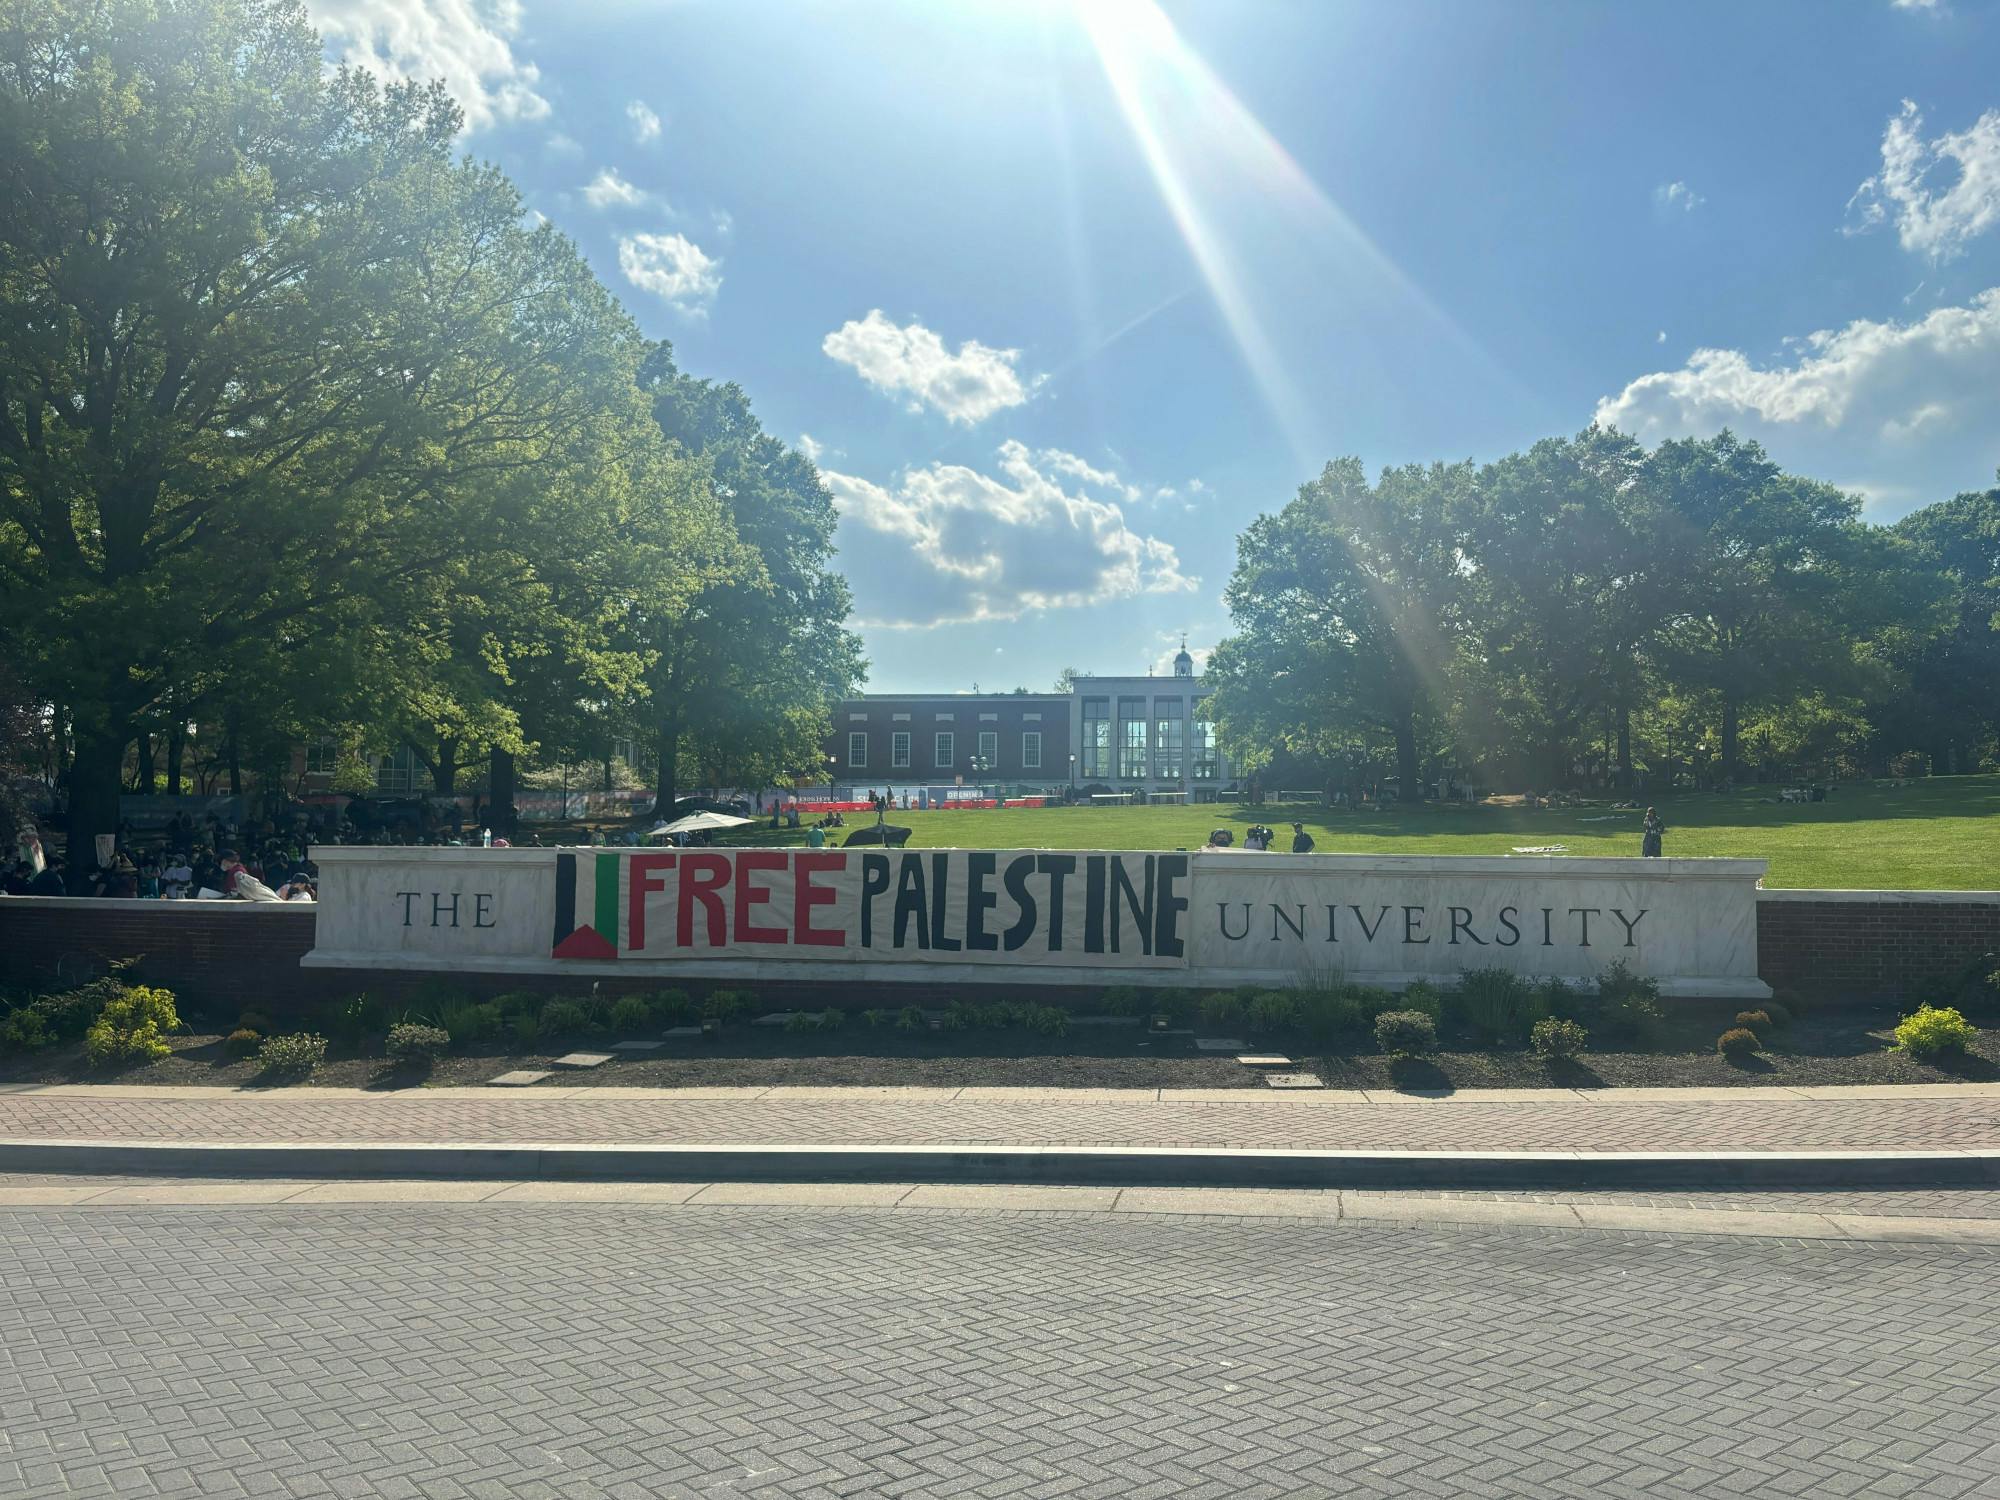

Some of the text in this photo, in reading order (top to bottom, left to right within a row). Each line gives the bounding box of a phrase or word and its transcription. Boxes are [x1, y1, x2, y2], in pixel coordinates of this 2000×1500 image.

[396, 892, 497, 928] THE
[628, 852, 1190, 957] FREE PALESTINE
[1216, 903, 1650, 947] UNIVERSITY
